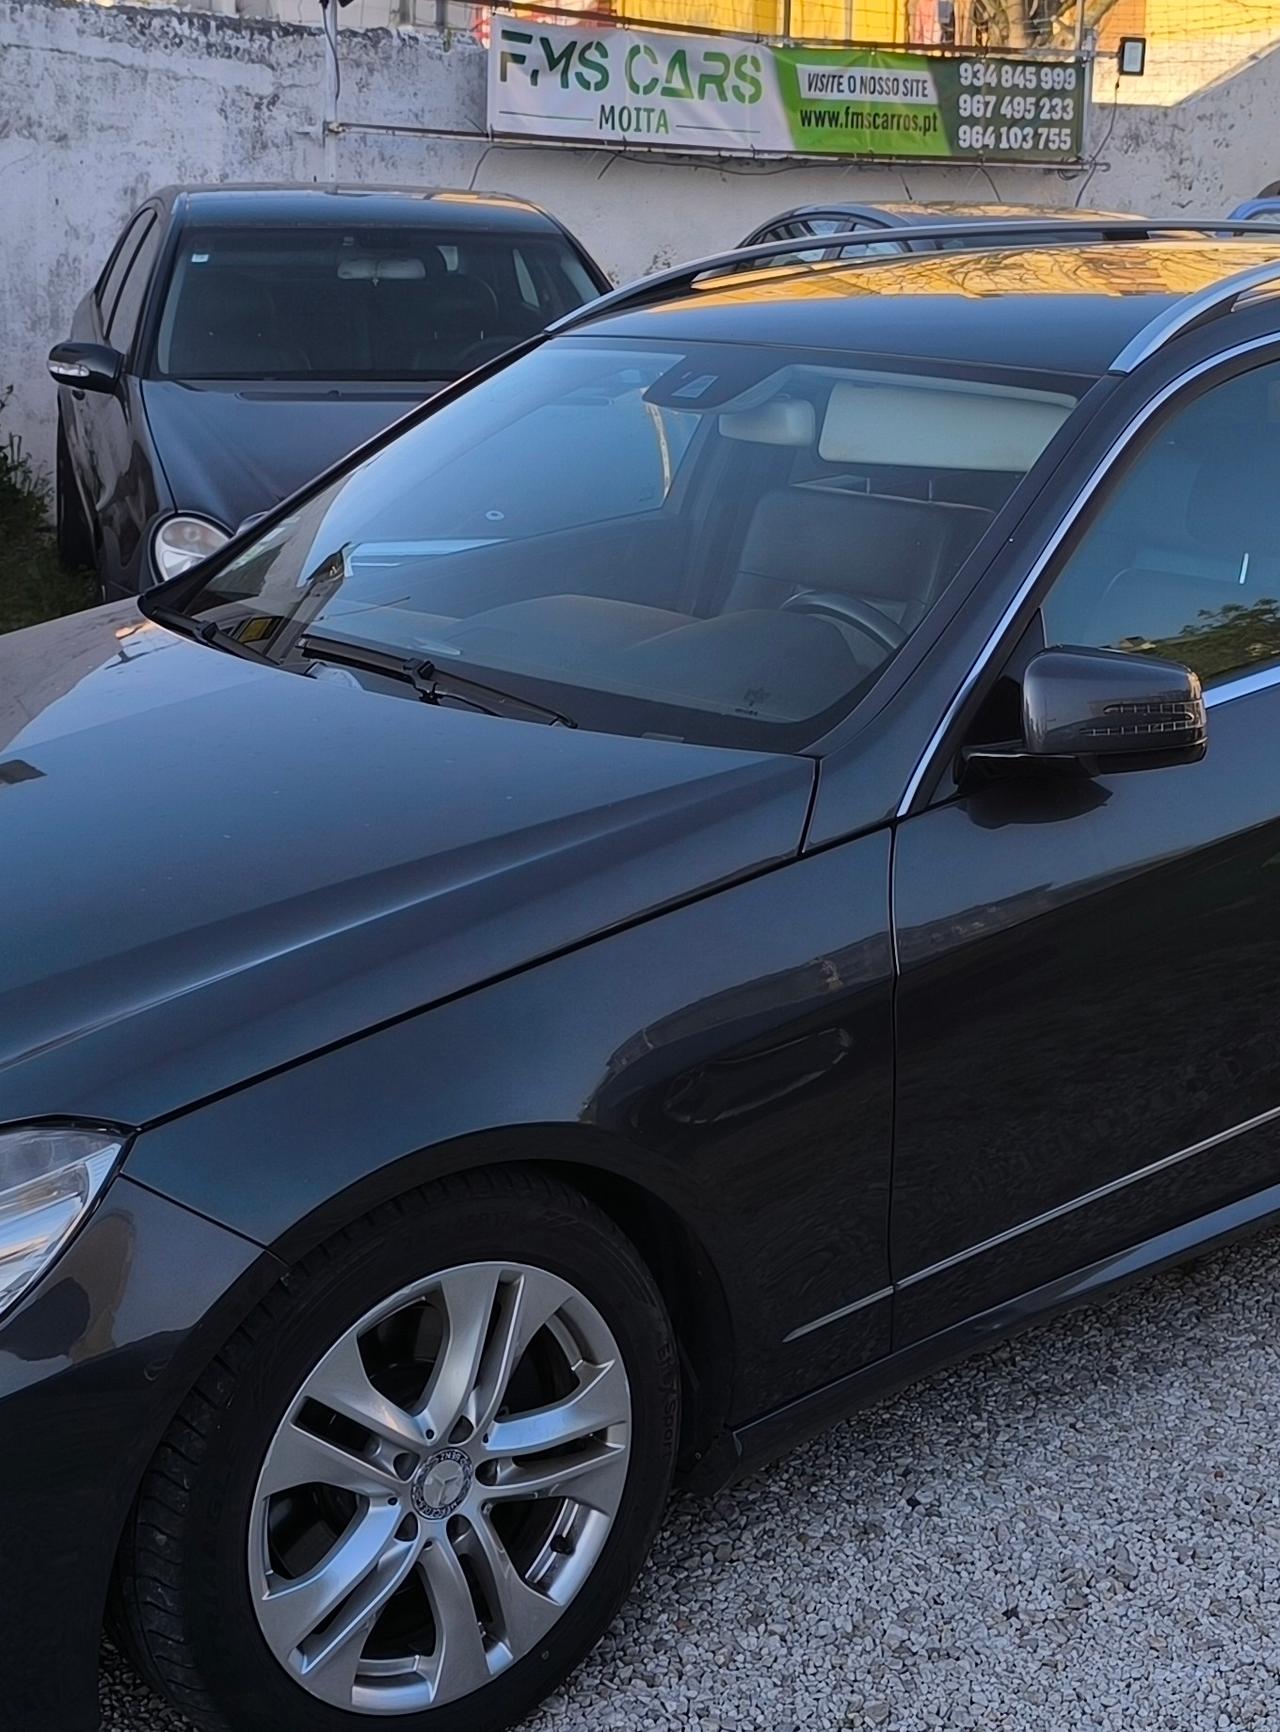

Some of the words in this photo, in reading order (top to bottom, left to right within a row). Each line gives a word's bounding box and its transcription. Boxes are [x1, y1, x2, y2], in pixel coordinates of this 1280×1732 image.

[500, 29, 609, 91] FMS
[625, 44, 762, 104] CARS
[959, 62, 998, 87] 934
[1001, 65, 1037, 89] 845
[1040, 67, 1076, 90] 999
[807, 73, 844, 93] VISITE
[848, 75, 856, 94] O
[860, 76, 899, 96] NOSSO
[902, 78, 928, 97] SITE
[599, 104, 669, 134] MOITA
[800, 106, 938, 136] www.fmscarros.pt
[959, 94, 997, 118] 967
[1000, 96, 1036, 119] 495
[1039, 97, 1074, 120] 233
[958, 125, 995, 149] 964
[1000, 126, 1034, 150] 103
[1038, 127, 1071, 151] 755
